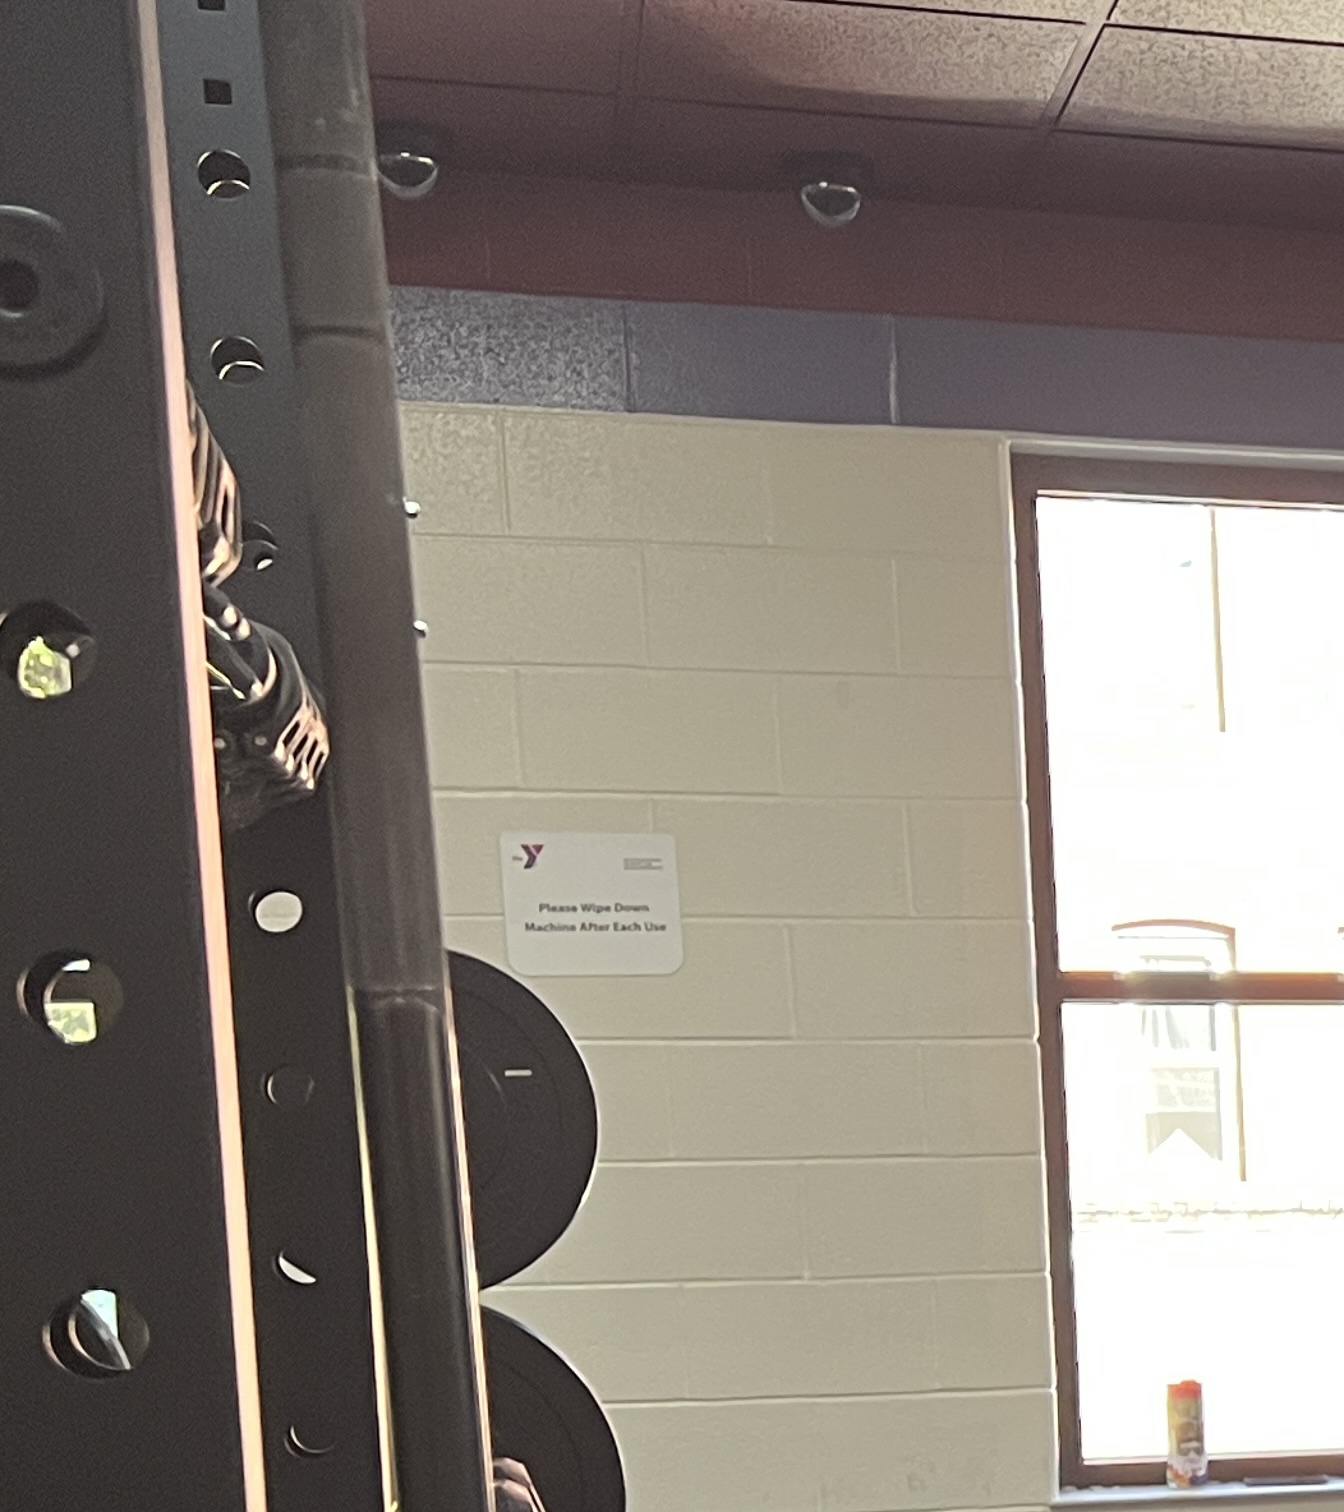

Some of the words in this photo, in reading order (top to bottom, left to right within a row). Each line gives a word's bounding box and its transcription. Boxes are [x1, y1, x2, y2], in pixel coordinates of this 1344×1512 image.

[539, 902, 578, 913] Please
[580, 903, 611, 914] Wipe
[614, 902, 649, 913] Down
[524, 921, 577, 932] Machine
[580, 921, 610, 932] After
[613, 921, 642, 932] Each
[644, 921, 667, 932] Use
